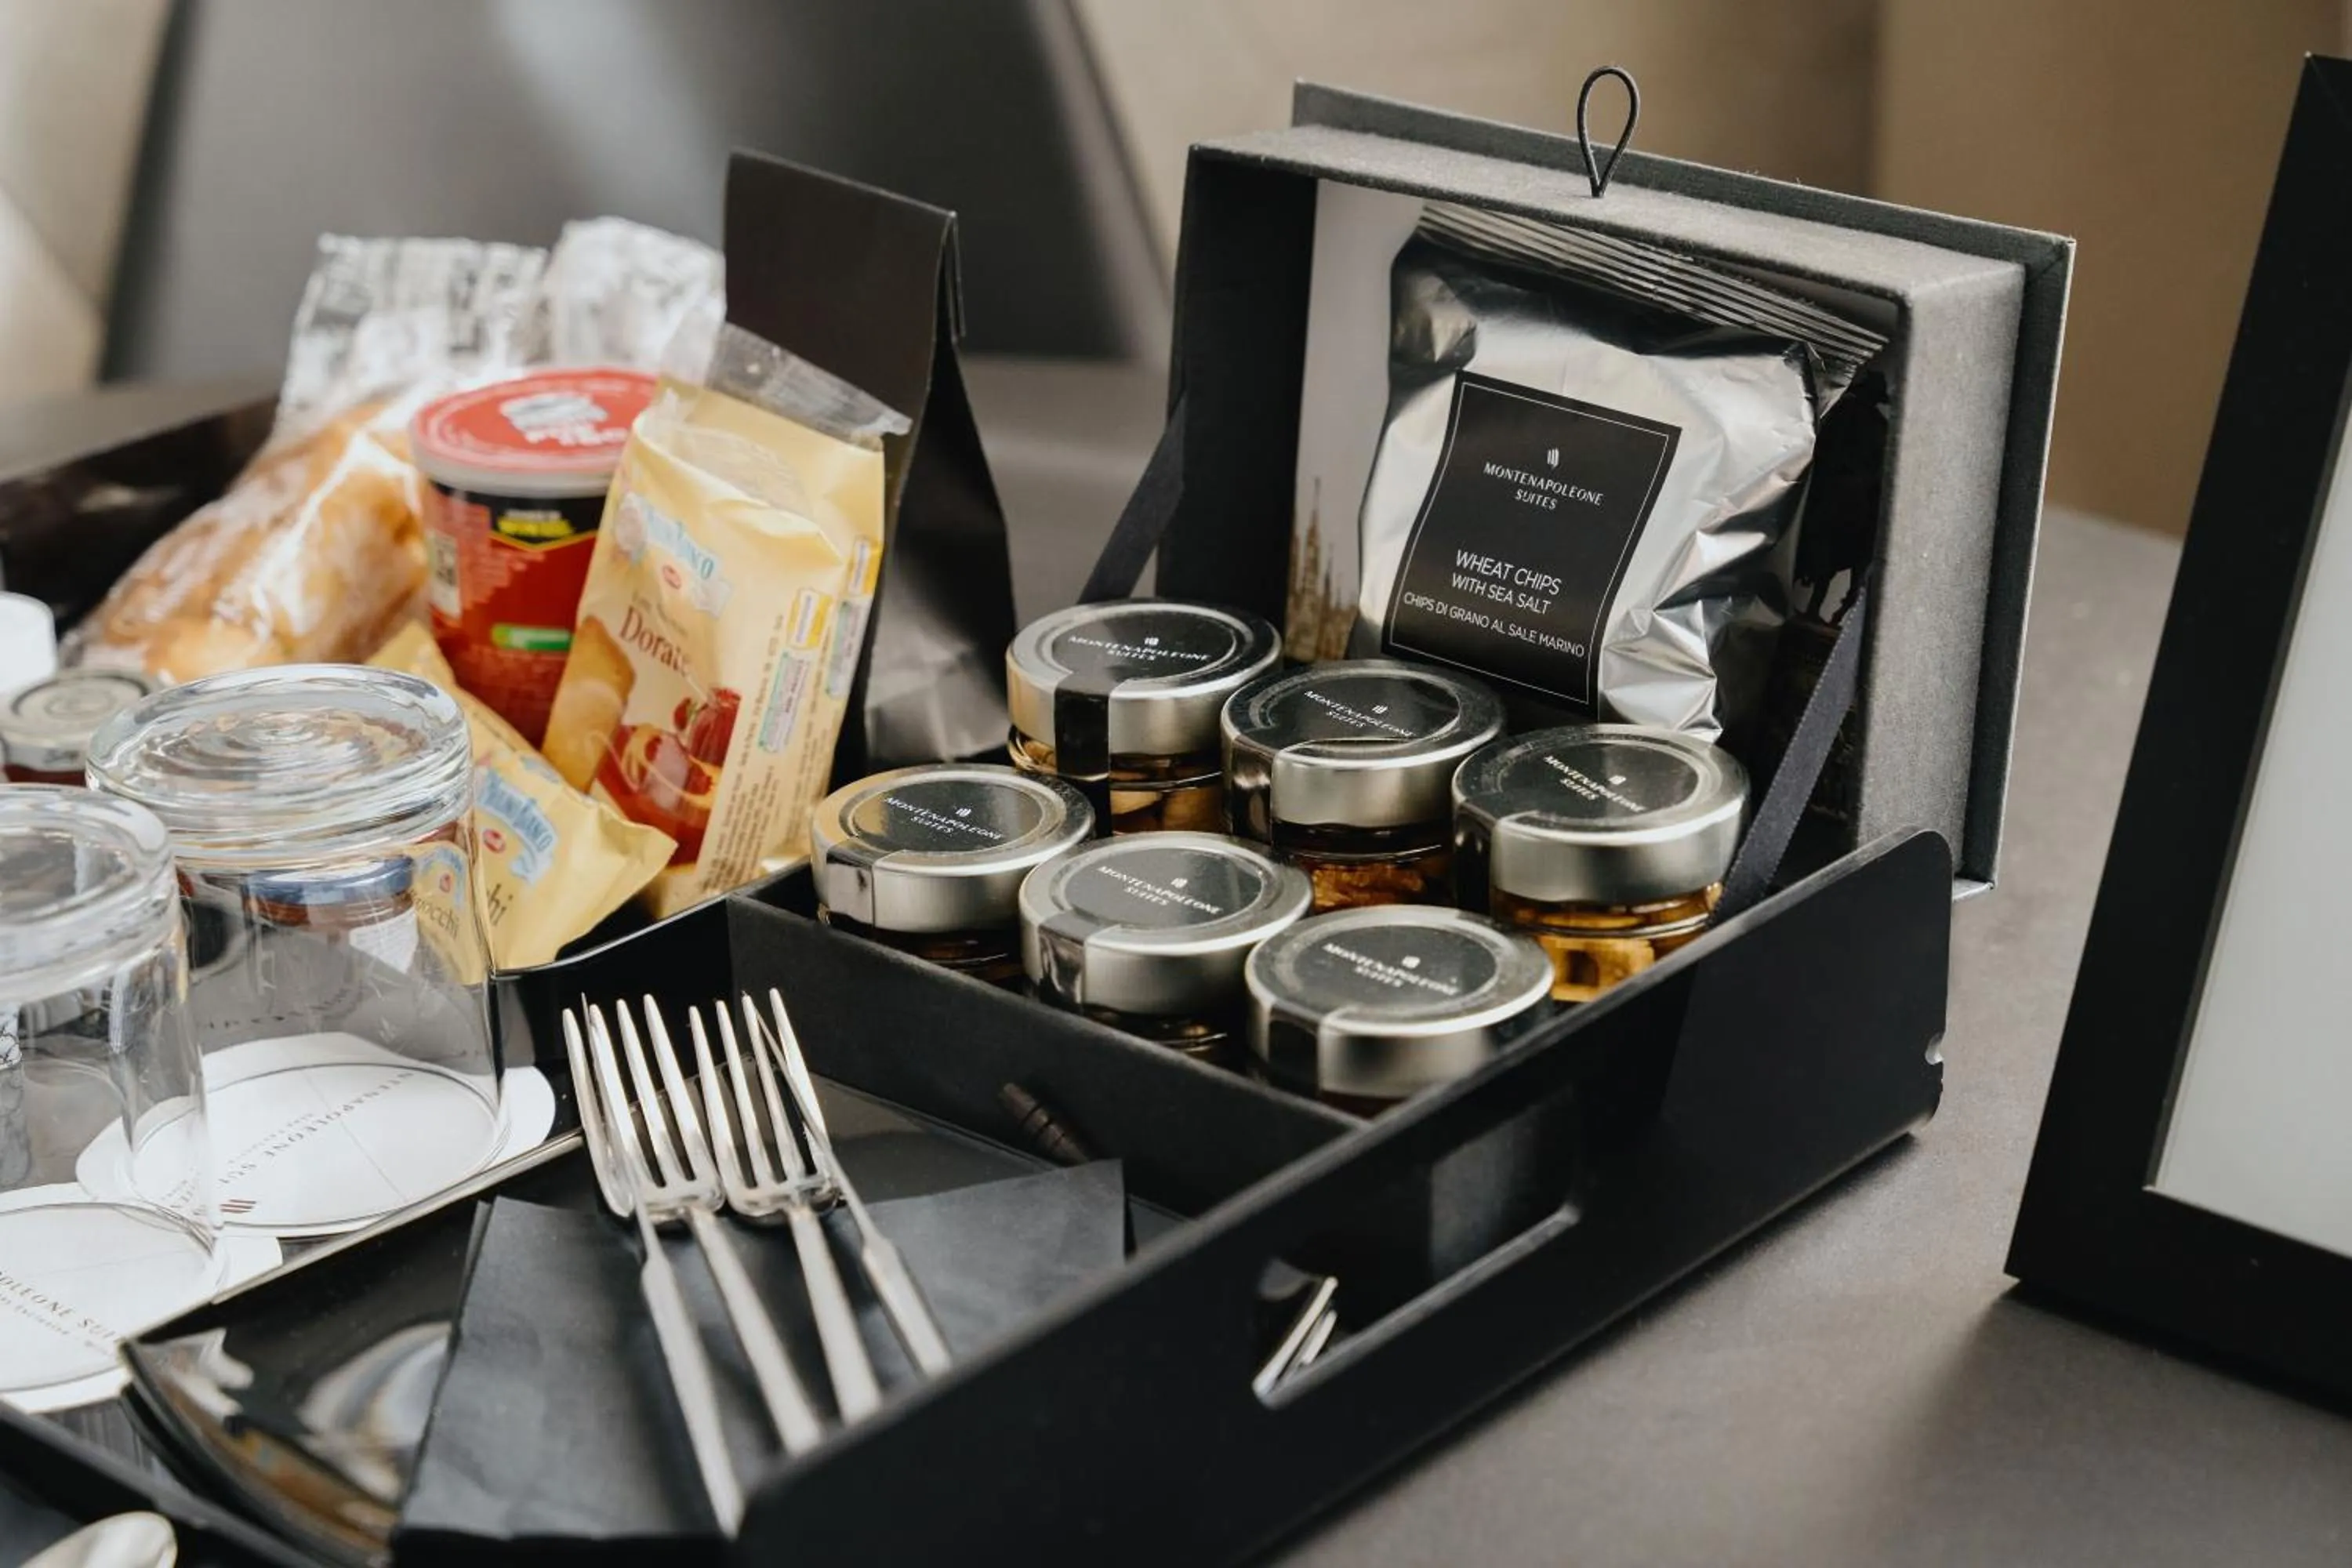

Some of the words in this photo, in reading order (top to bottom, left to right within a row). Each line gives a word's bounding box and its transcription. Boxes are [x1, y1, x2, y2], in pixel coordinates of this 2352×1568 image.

[1483, 462, 1605, 506] MONTENAPOLEONE
[1515, 488, 1559, 510] SUITES
[1452, 572, 1486, 597] WITH
[1487, 584, 1514, 604] SEA
[1515, 592, 1552, 615] SALT
[1456, 550, 1512, 582] WHEAT
[1514, 567, 1563, 596] CHIPS
[1403, 591, 1435, 612] CHIPS
[1436, 601, 1449, 615] DI
[1449, 605, 1490, 629] GRANO
[1490, 618, 1506, 635] AL
[1508, 622, 1537, 644] SALE
[1538, 632, 1585, 659] MARINO
[1098, 865, 1224, 916] MONTENAPOLEONE
